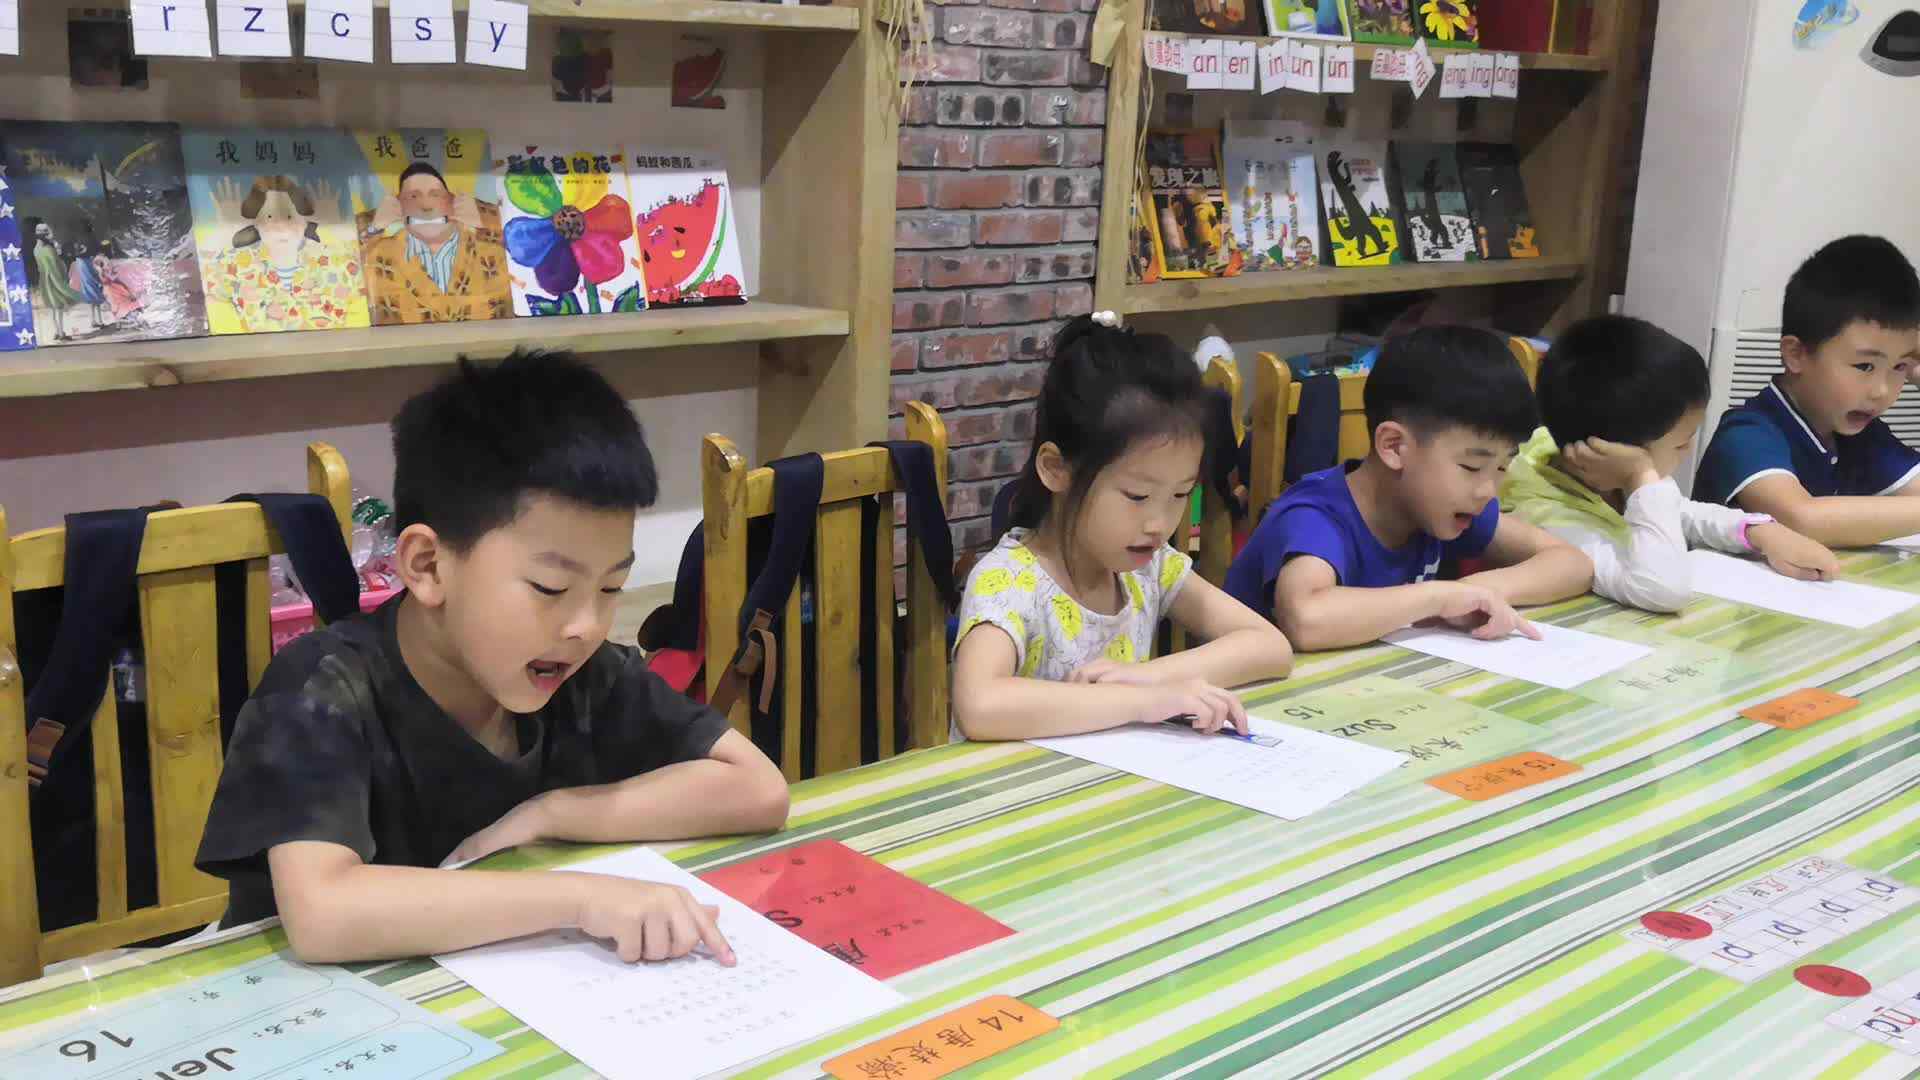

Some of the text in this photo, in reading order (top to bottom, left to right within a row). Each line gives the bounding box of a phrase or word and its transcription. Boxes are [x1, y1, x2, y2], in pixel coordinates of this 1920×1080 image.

[162, 6, 507, 52] r z c s y
[1193, 54, 1218, 73] an
[1228, 55, 1249, 74] en
[1292, 56, 1313, 77] un
[215, 139, 315, 164] 我妈妈
[374, 135, 463, 158] 我爸爸
[507, 154, 612, 175] 彩虹色的花
[1283, 704, 1325, 721] 15
[1317, 718, 1397, 738] Suz
[977, 1009, 1024, 1031] 14
[59, 1029, 135, 1063] 16
